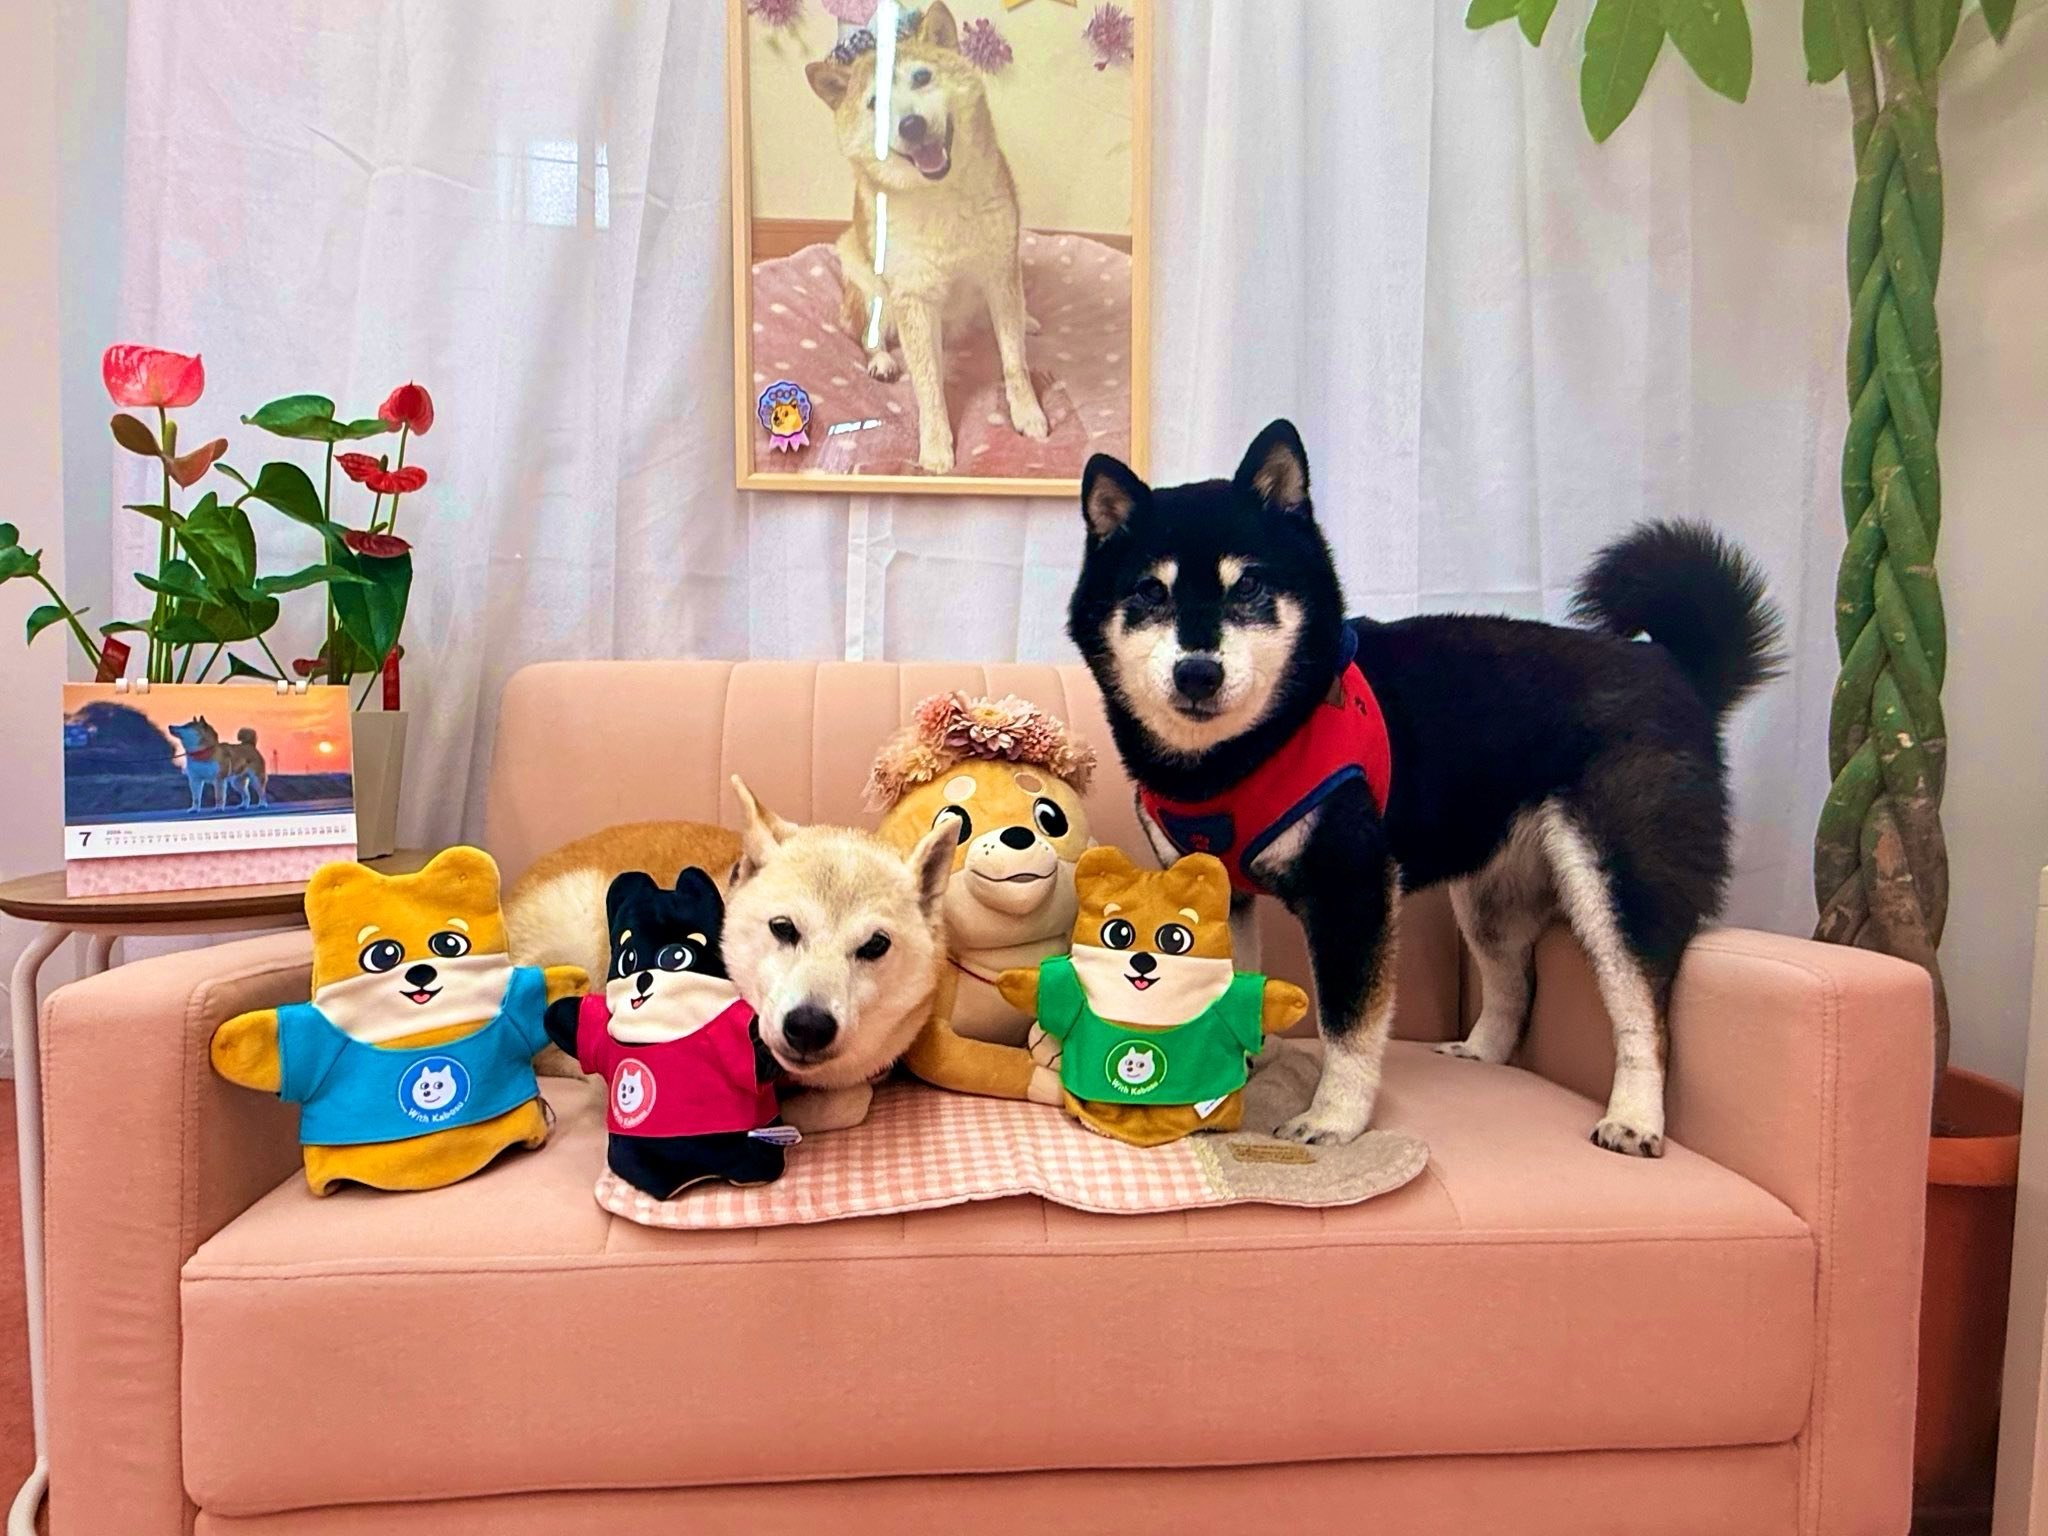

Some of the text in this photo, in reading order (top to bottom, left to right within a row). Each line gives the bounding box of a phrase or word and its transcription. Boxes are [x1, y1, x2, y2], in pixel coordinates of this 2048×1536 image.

[79, 831, 92, 847] 7
[1111, 1078, 1129, 1094] With
[408, 1107, 429, 1122] With
